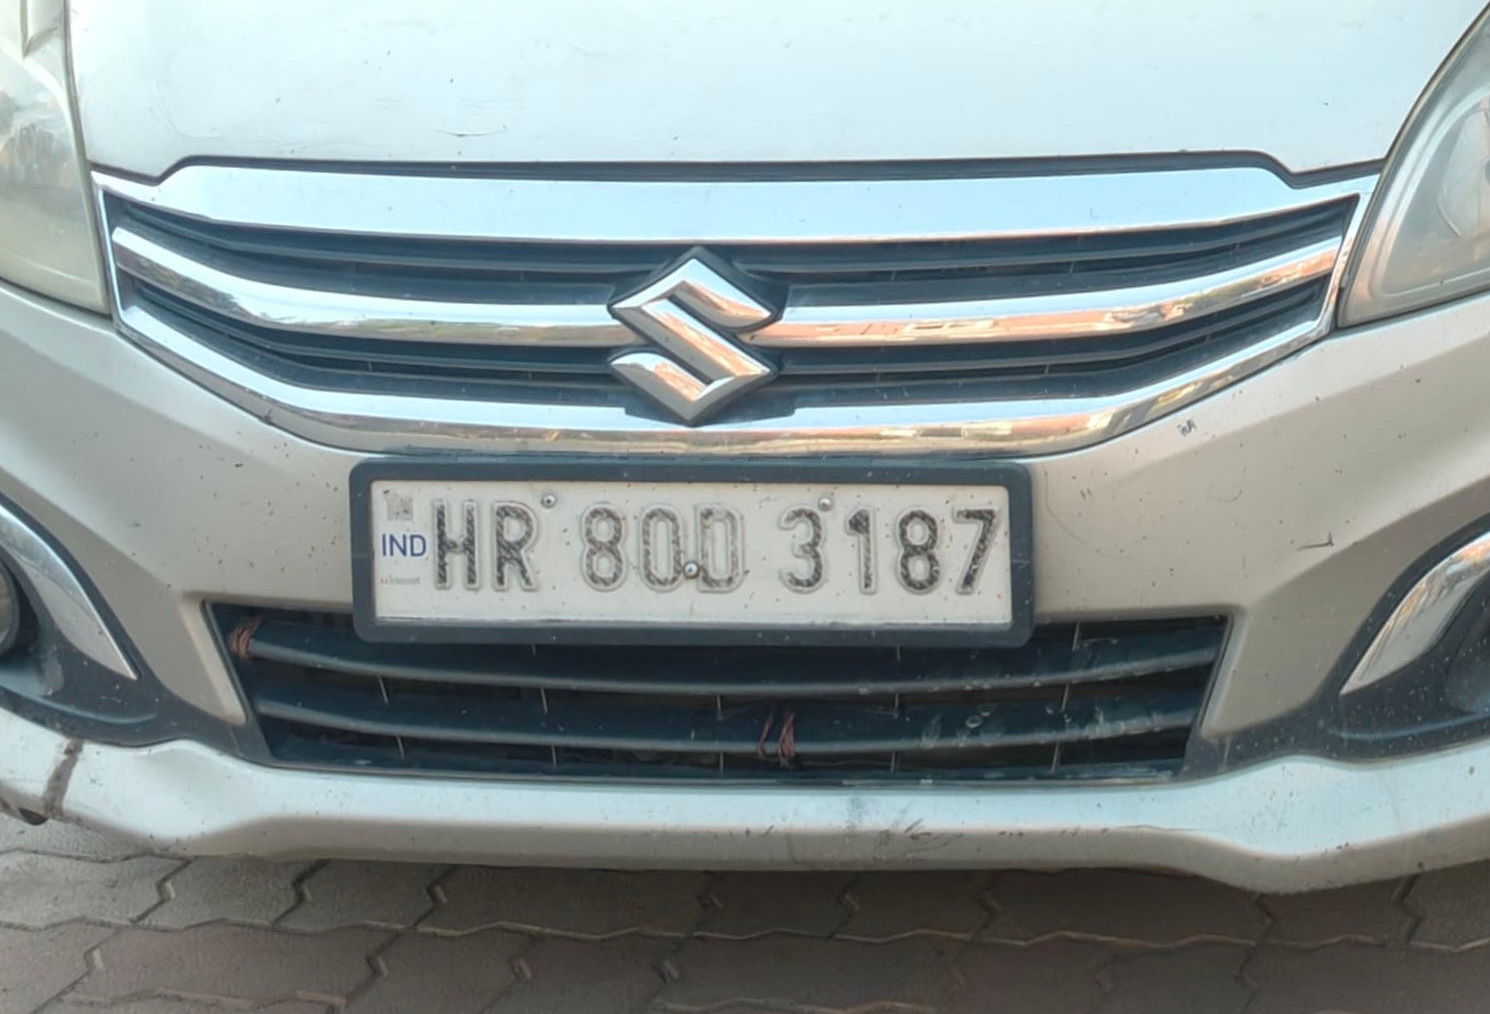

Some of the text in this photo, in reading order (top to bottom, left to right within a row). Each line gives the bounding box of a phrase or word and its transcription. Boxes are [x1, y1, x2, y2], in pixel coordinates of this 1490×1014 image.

[382, 533, 427, 557] IND
[432, 500, 538, 591] HR
[778, 504, 998, 594] 3187
